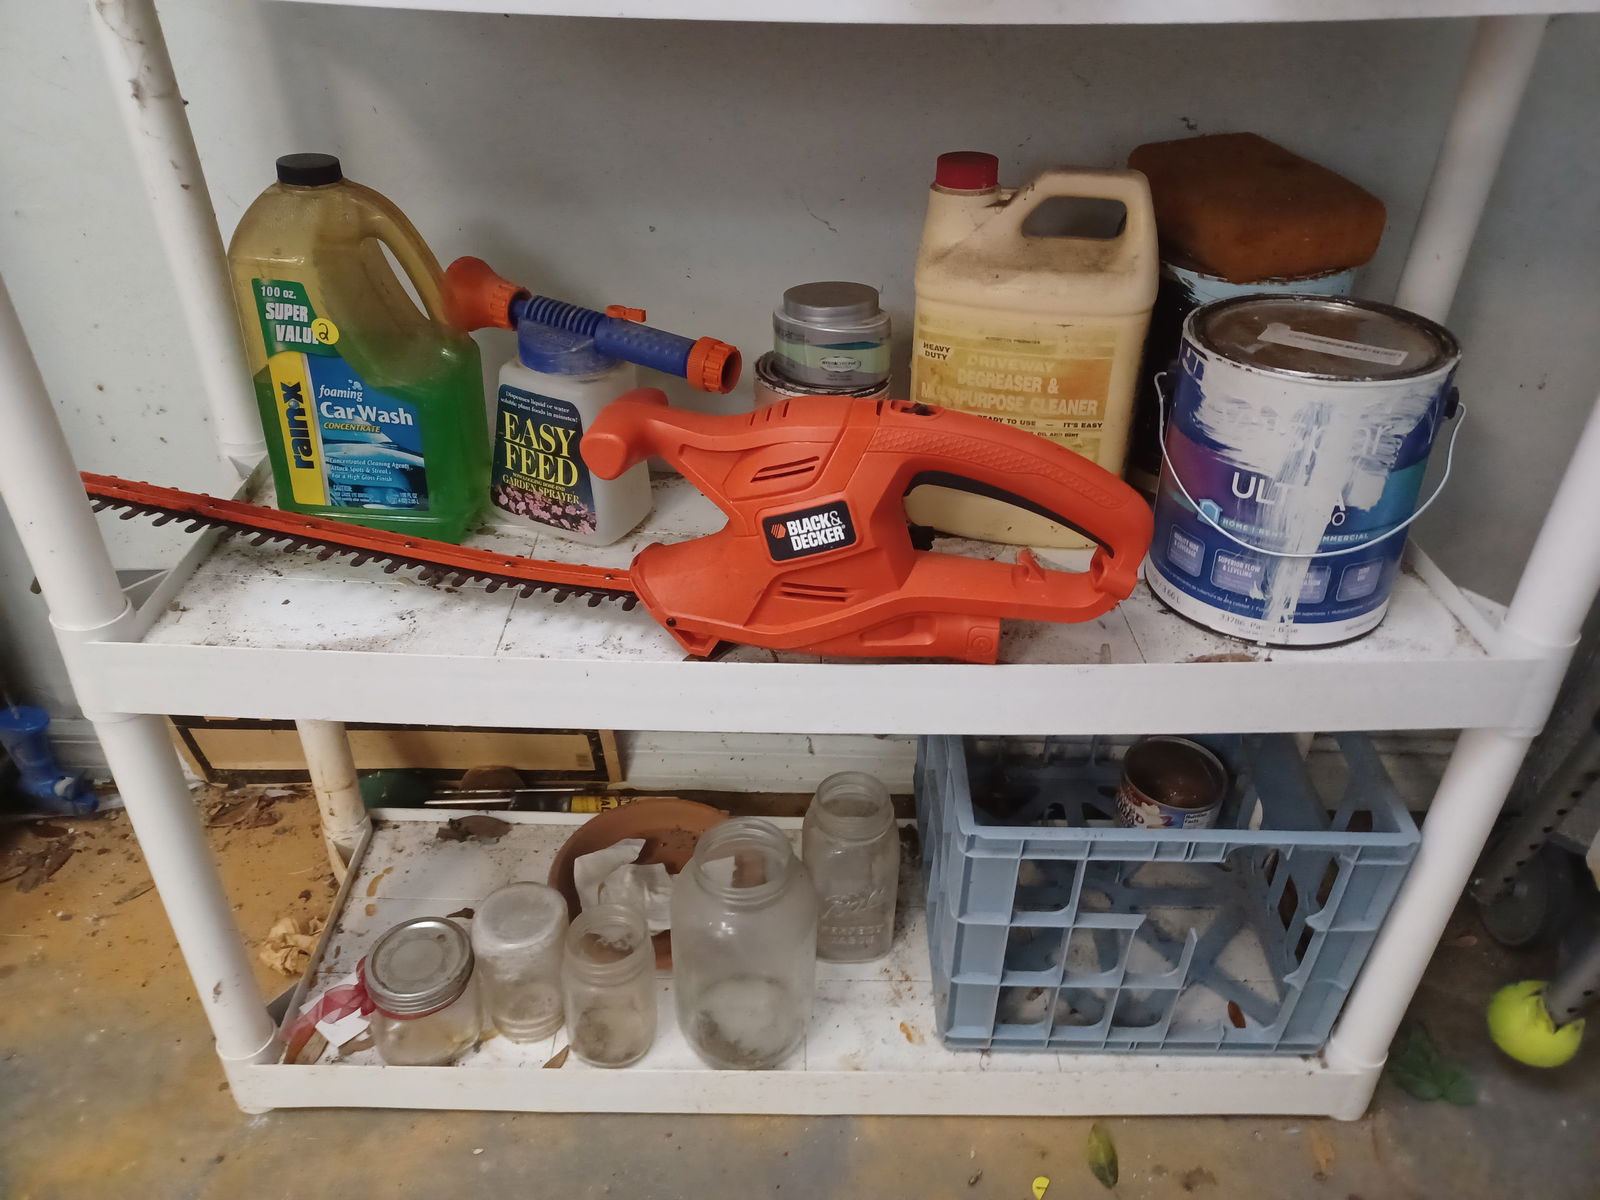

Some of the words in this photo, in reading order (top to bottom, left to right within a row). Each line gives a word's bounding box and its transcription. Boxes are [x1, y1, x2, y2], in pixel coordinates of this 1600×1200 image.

[261, 286, 280, 297] 100
[283, 290, 296, 299] oz.
[265, 302, 308, 323] SUPER
[318, 323, 329, 341] 2
[923, 341, 951, 353] HEAVY
[924, 350, 948, 361] DUTY
[967, 355, 1056, 373] DRIVEWAY
[958, 369, 1042, 394] DEGREASER
[1047, 377, 1059, 394] &
[318, 385, 363, 402] foaming
[320, 401, 355, 420] Car
[357, 404, 413, 426] Wash
[517, 403, 531, 411] plant
[531, 406, 546, 415] foods
[531, 398, 546, 408] liquid
[553, 405, 570, 413] water
[1030, 397, 1098, 416] CLEANER
[324, 422, 381, 433] CONCENTRATE
[503, 411, 576, 458] EASY
[504, 440, 578, 487] FEED
[502, 474, 537, 493] GARDEN
[538, 486, 580, 505] SPRAYER
[790, 525, 845, 551] DECKER
[1222, 518, 1249, 532] HOME
[1322, 533, 1369, 543] MMERCIAL
[1245, 561, 1261, 572] FLOW
